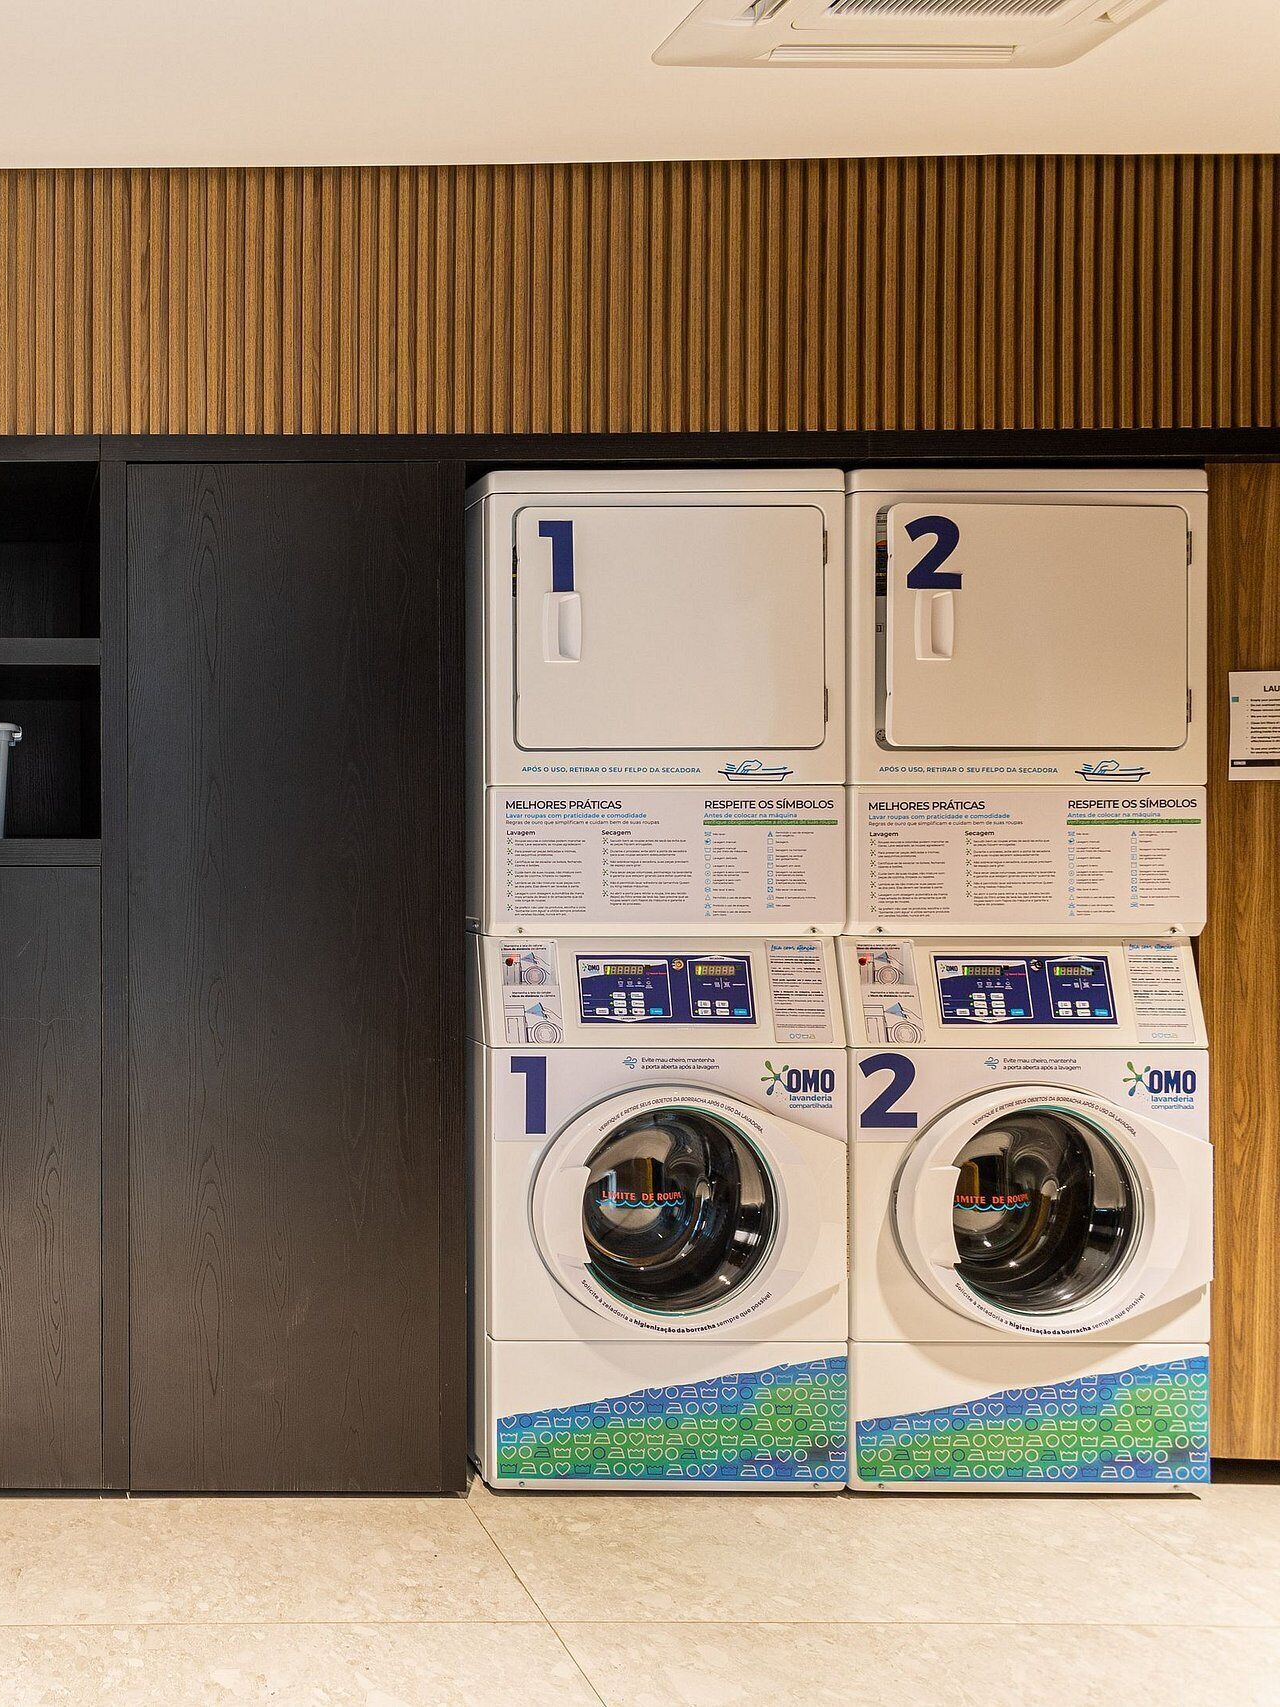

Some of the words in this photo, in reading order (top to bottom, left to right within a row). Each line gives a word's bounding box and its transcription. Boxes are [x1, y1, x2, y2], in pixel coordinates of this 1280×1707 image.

[539, 520, 574, 592] 1
[904, 515, 962, 589] 2
[506, 800, 566, 809] MELHORES
[570, 799, 621, 809] PRÁTICAS
[705, 800, 755, 809] RESPEITE
[759, 800, 773, 809] OS
[776, 798, 834, 809] SÍMBOLOS
[869, 802, 929, 810] MELHORES
[933, 800, 985, 810] PRÁTICAS
[1068, 800, 1119, 809] RESPEITE
[1122, 800, 1137, 808] OS
[1140, 798, 1197, 808] SÍMBOLOS
[787, 1069, 835, 1093] OMO
[1149, 1070, 1196, 1094] OMO
[511, 1056, 547, 1134] 1
[858, 1052, 918, 1128] 2
[1151, 1095, 1193, 1103] lavanderia
[602, 1191, 635, 1200] LIMITE
[955, 1195, 986, 1204] IMITE
[992, 1196, 1004, 1204] DE
[581, 1279, 600, 1300] Solicite
[602, 1302, 629, 1321] zeladoria
[634, 1319, 675, 1333] higienização
[686, 1324, 716, 1333] borracha
[716, 1315, 739, 1327] sempre
[740, 1309, 752, 1318] que
[751, 1292, 772, 1311] possível
